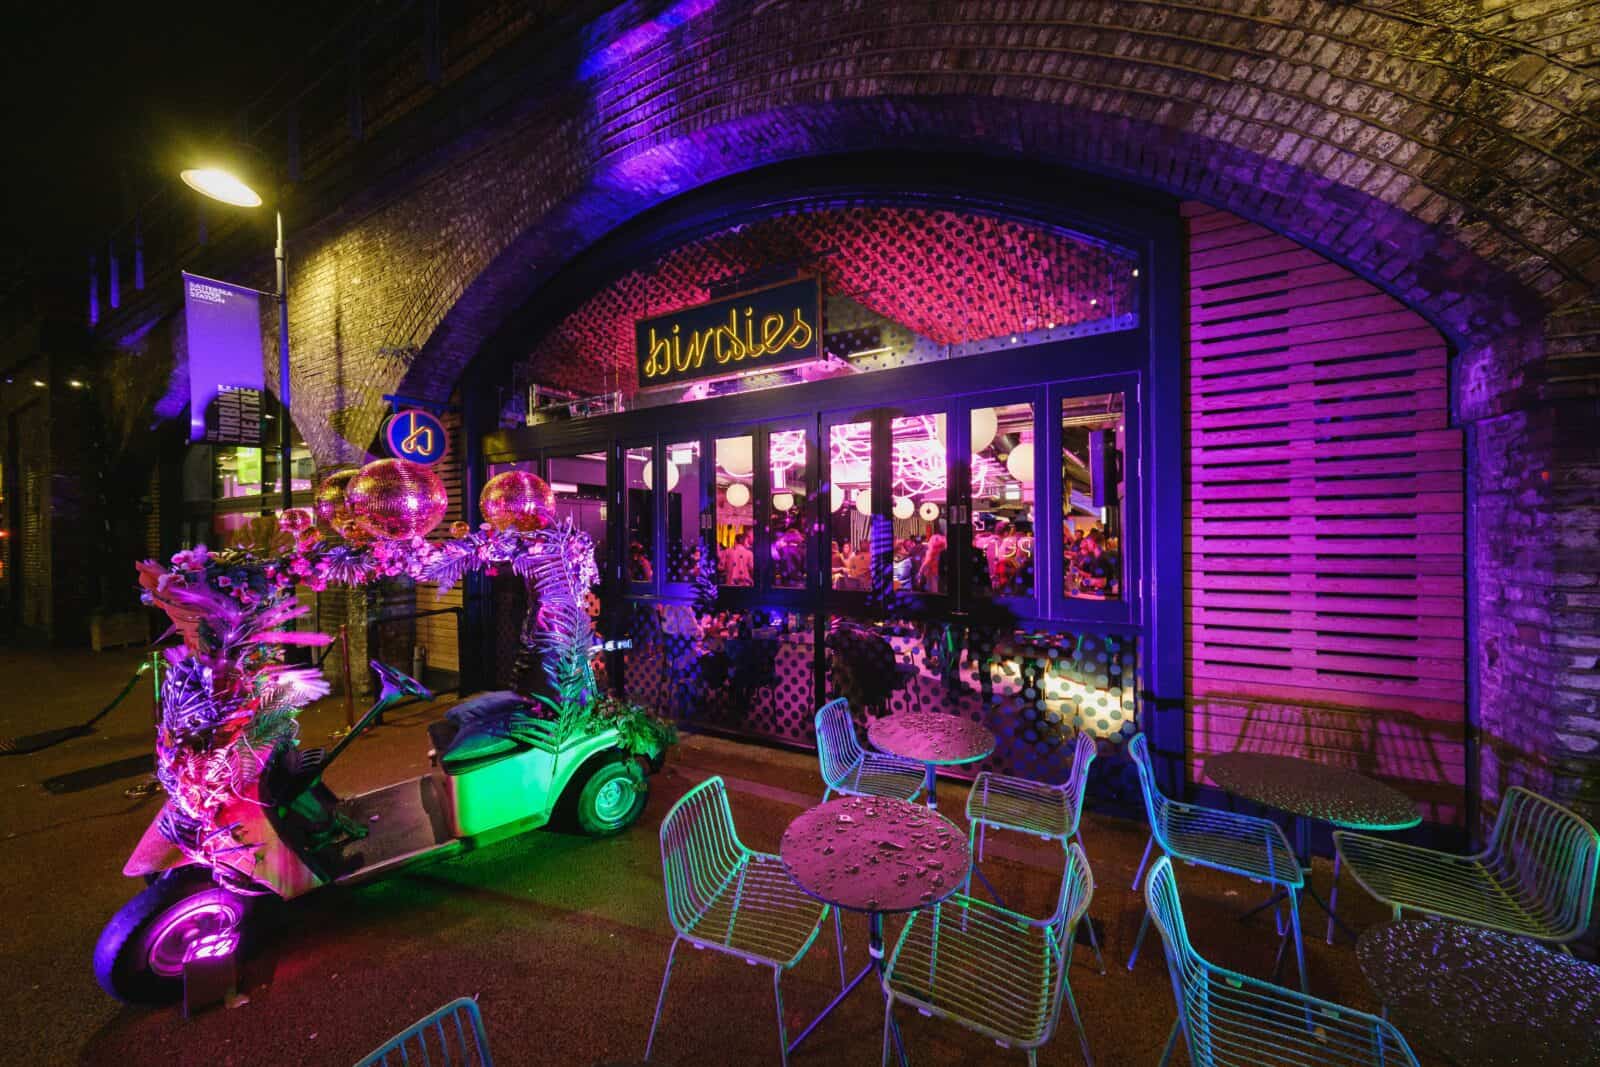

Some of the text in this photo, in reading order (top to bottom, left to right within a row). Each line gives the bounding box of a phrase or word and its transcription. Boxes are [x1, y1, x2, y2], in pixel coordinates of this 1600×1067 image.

[190, 282, 233, 296] BATTERSEA
[190, 291, 226, 304] STATION
[644, 305, 813, 378] birdies
[216, 384, 240, 442] TURBINE
[240, 387, 260, 444] THEATRE
